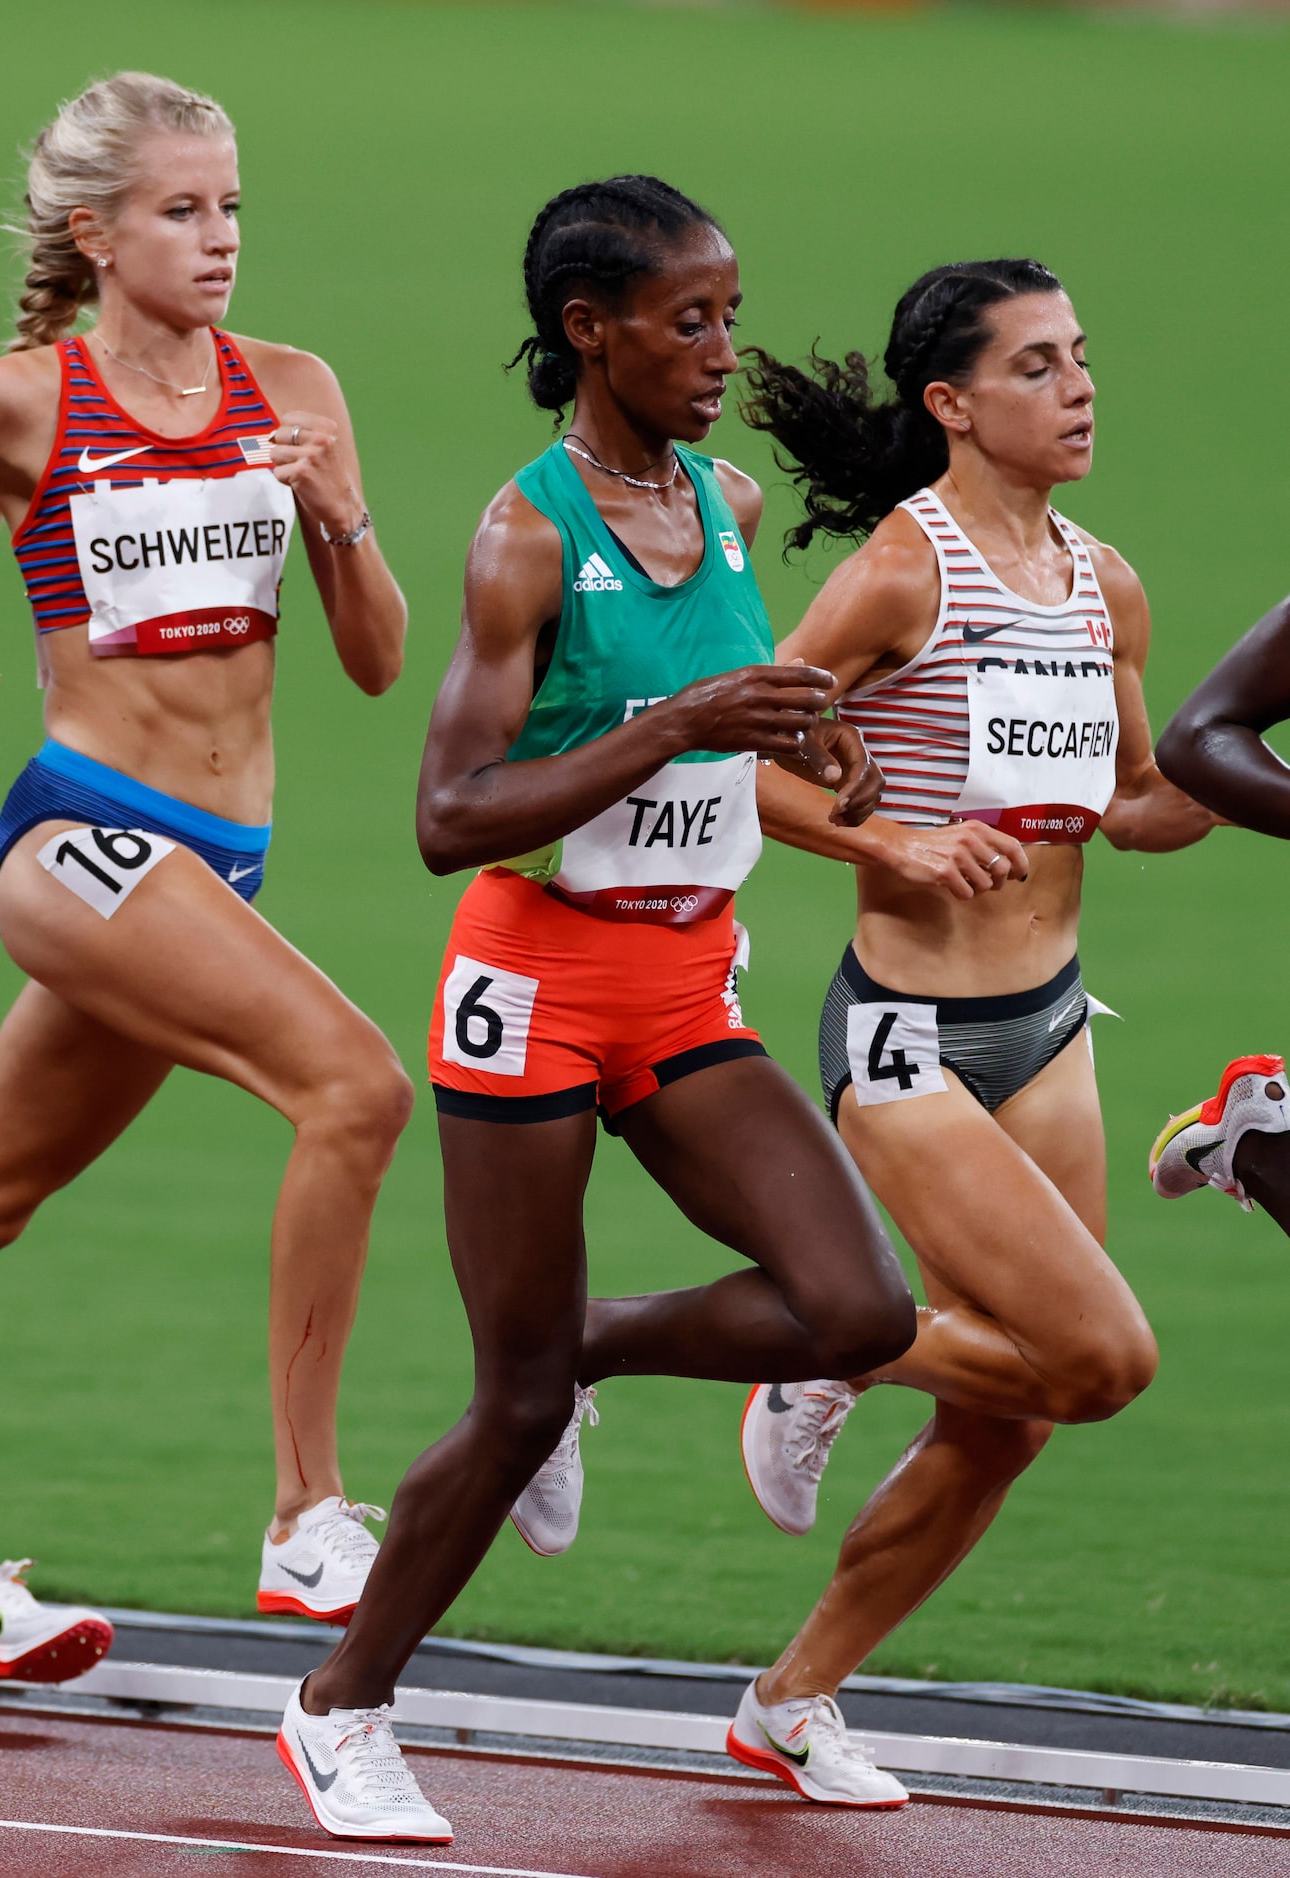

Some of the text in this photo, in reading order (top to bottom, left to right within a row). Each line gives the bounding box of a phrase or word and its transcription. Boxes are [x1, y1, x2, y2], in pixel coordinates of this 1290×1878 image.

[90, 519, 286, 574] SCHWEIZER
[573, 575, 624, 592] adidas
[159, 622, 221, 640] TOKYO 2020
[987, 717, 1114, 758] SECCAFIEN
[626, 796, 722, 848] TAYE
[1021, 818, 1064, 830] TOKYO 2020
[56, 828, 152, 895] 16
[615, 899, 668, 910] TOKYO 2020
[456, 975, 503, 1058] 6
[868, 1012, 920, 1091] 4
